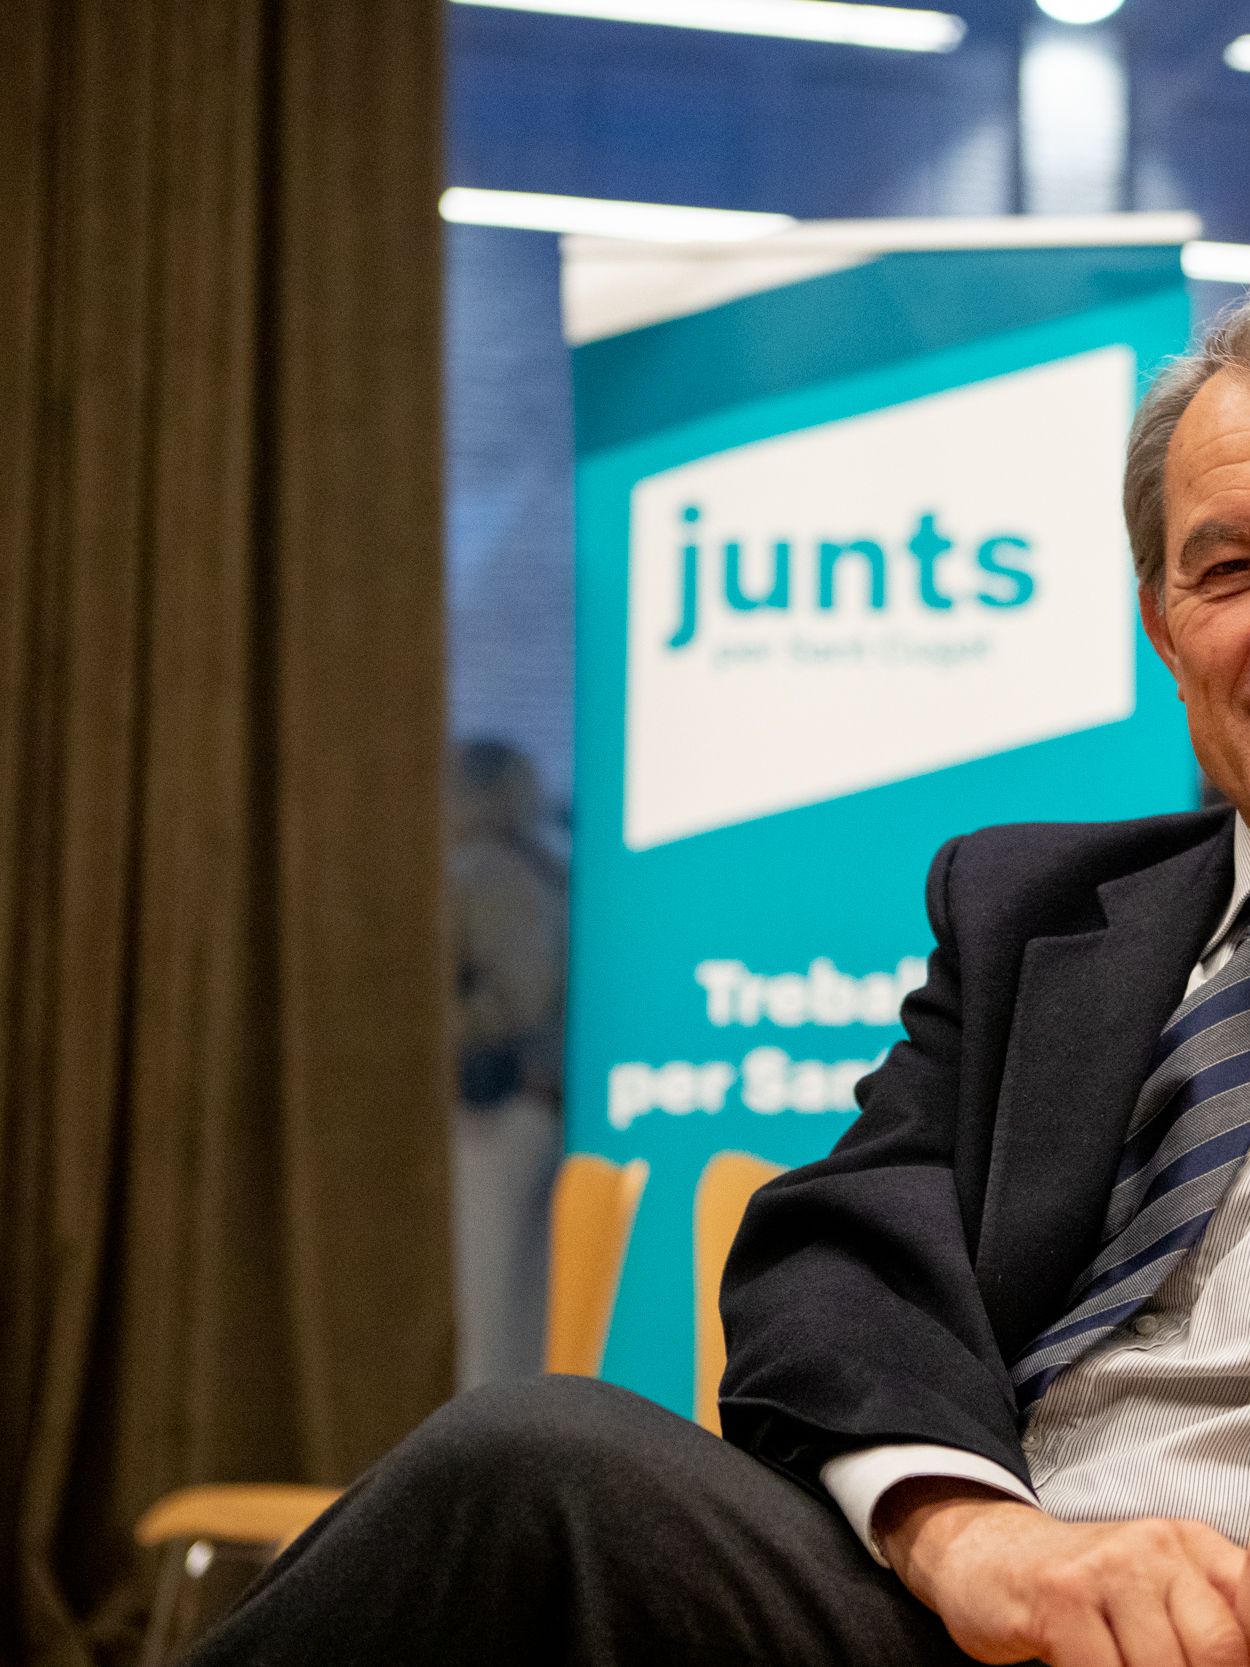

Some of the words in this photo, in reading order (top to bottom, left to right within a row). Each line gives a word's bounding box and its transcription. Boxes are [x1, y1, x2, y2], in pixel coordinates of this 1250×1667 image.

[666, 504, 1036, 651] junts
[608, 1062, 733, 1130] per
[742, 1047, 888, 1114] San
